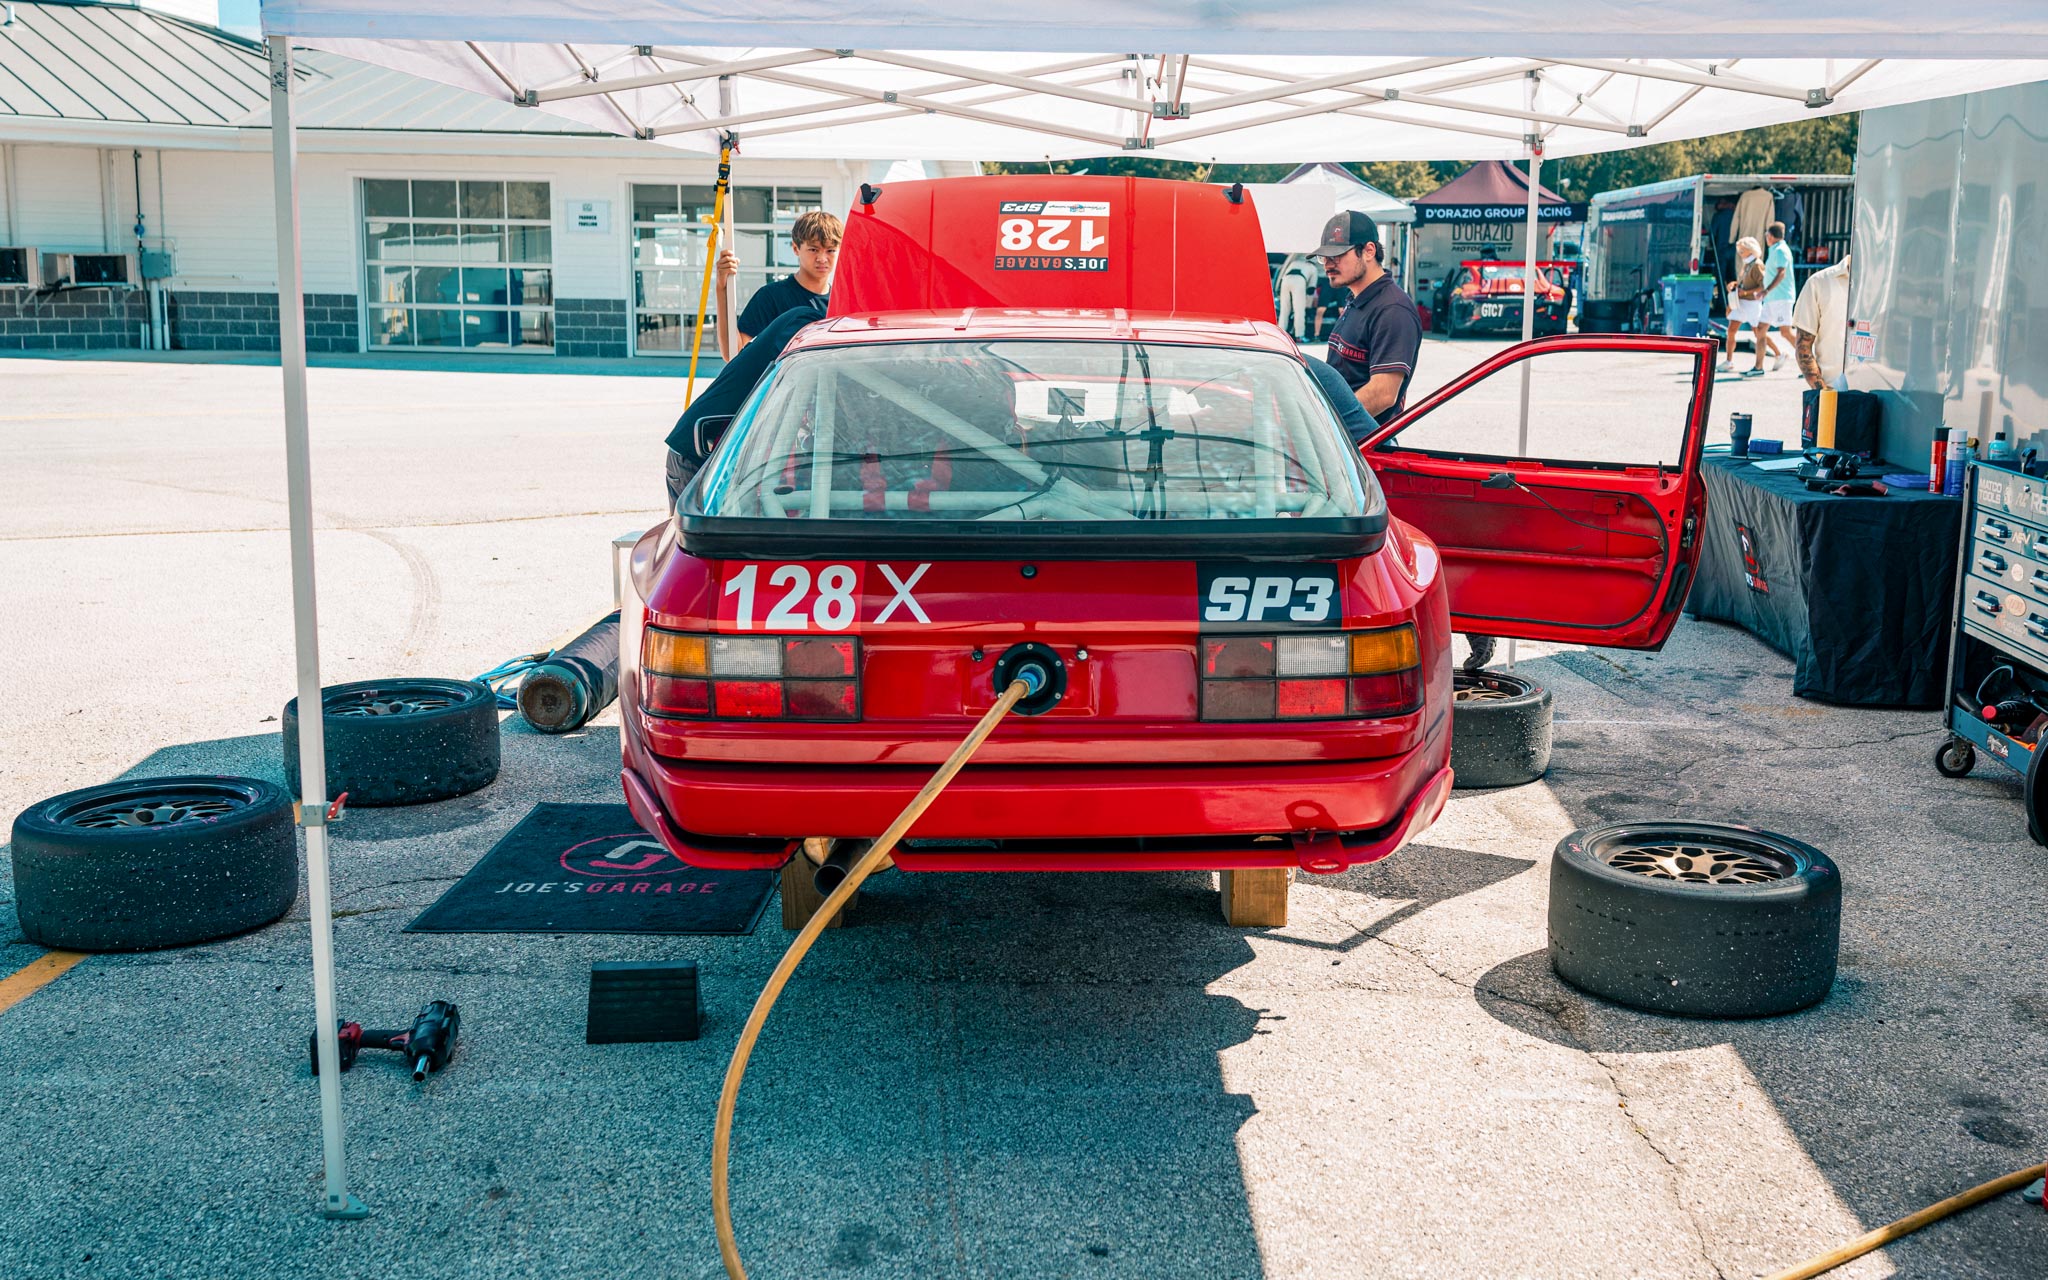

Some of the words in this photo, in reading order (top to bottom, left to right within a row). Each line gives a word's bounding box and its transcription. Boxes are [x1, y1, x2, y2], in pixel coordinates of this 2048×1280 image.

[1002, 203, 1043, 212] SP3
[1425, 207, 1482, 219] D'ORAZIO
[1484, 207, 1525, 218] GROUP
[1536, 206, 1572, 218] ACING
[1000, 218, 1105, 252] 128
[1452, 223, 1513, 242] D'ORAZIO
[1481, 303, 1503, 317] GTC7
[1979, 478, 2003, 494] MATCO
[1978, 488, 2001, 505] TOOLS
[957, 525, 1101, 535] PORSCHE
[724, 564, 857, 632] 128
[873, 563, 932, 625] X
[1204, 576, 1335, 622] SP3
